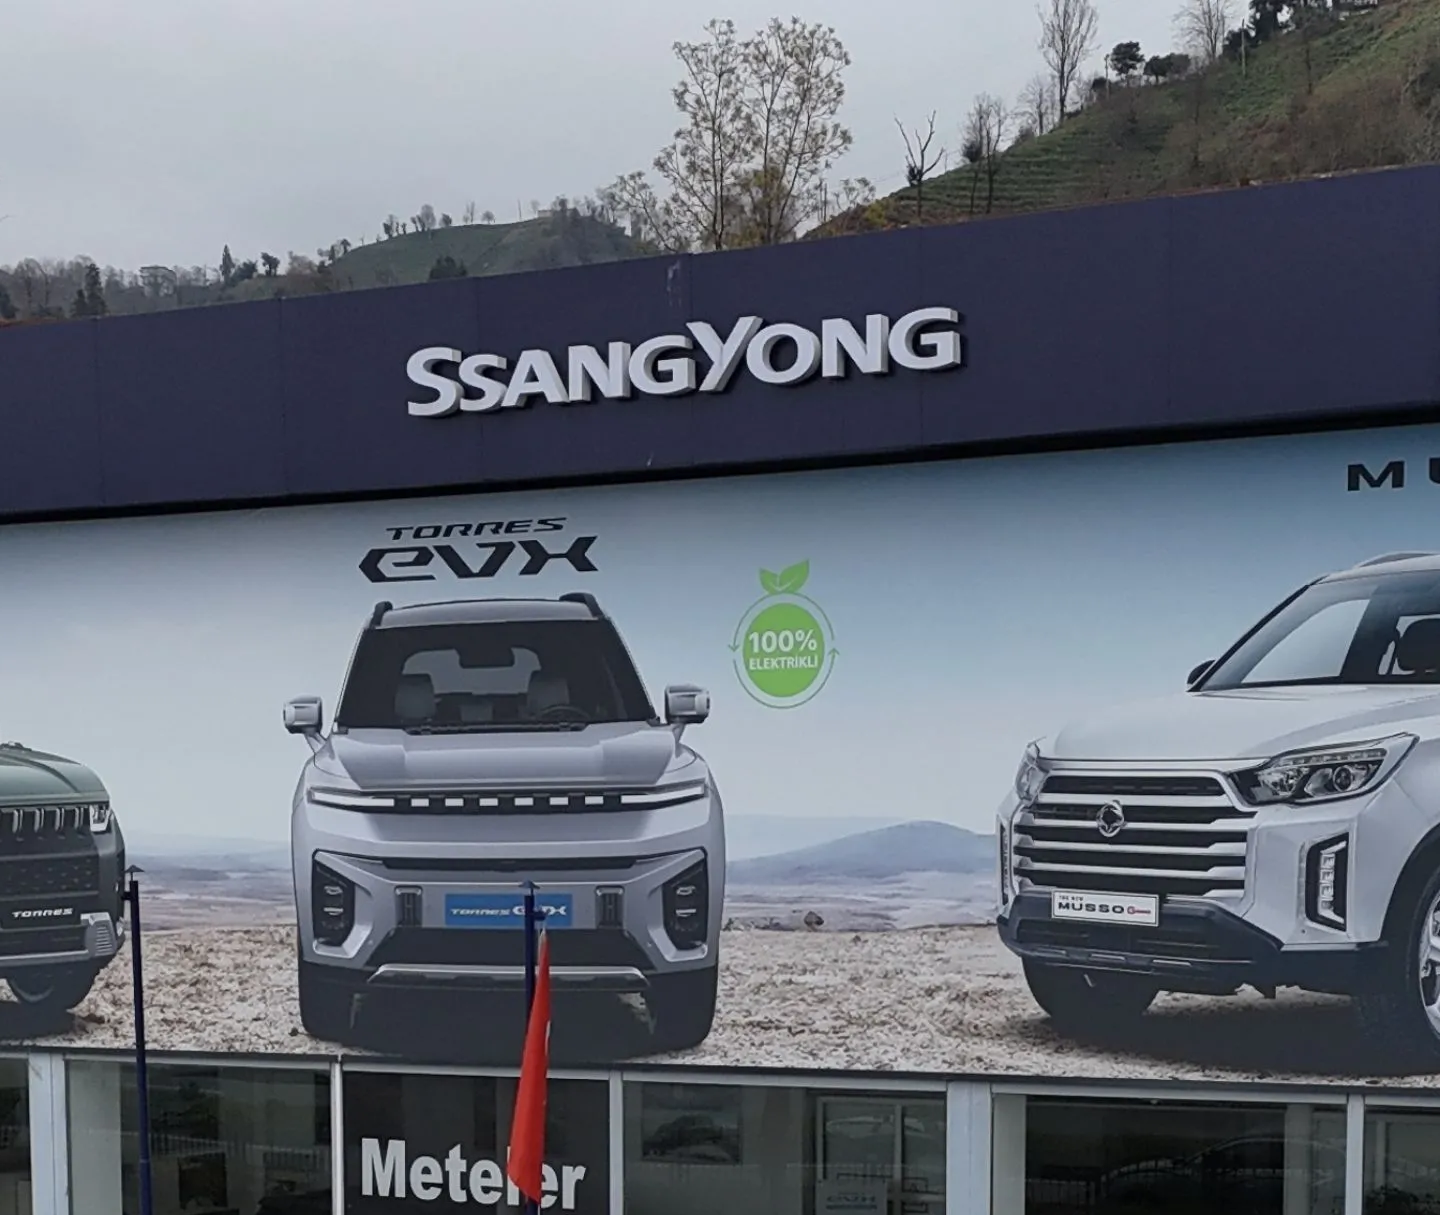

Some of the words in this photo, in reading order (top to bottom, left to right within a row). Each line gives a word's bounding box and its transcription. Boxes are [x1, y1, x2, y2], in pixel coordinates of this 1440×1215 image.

[386, 517, 567, 541] TORRES
[748, 629, 817, 653] 100%
[1058, 902, 1124, 914] MUSSO
